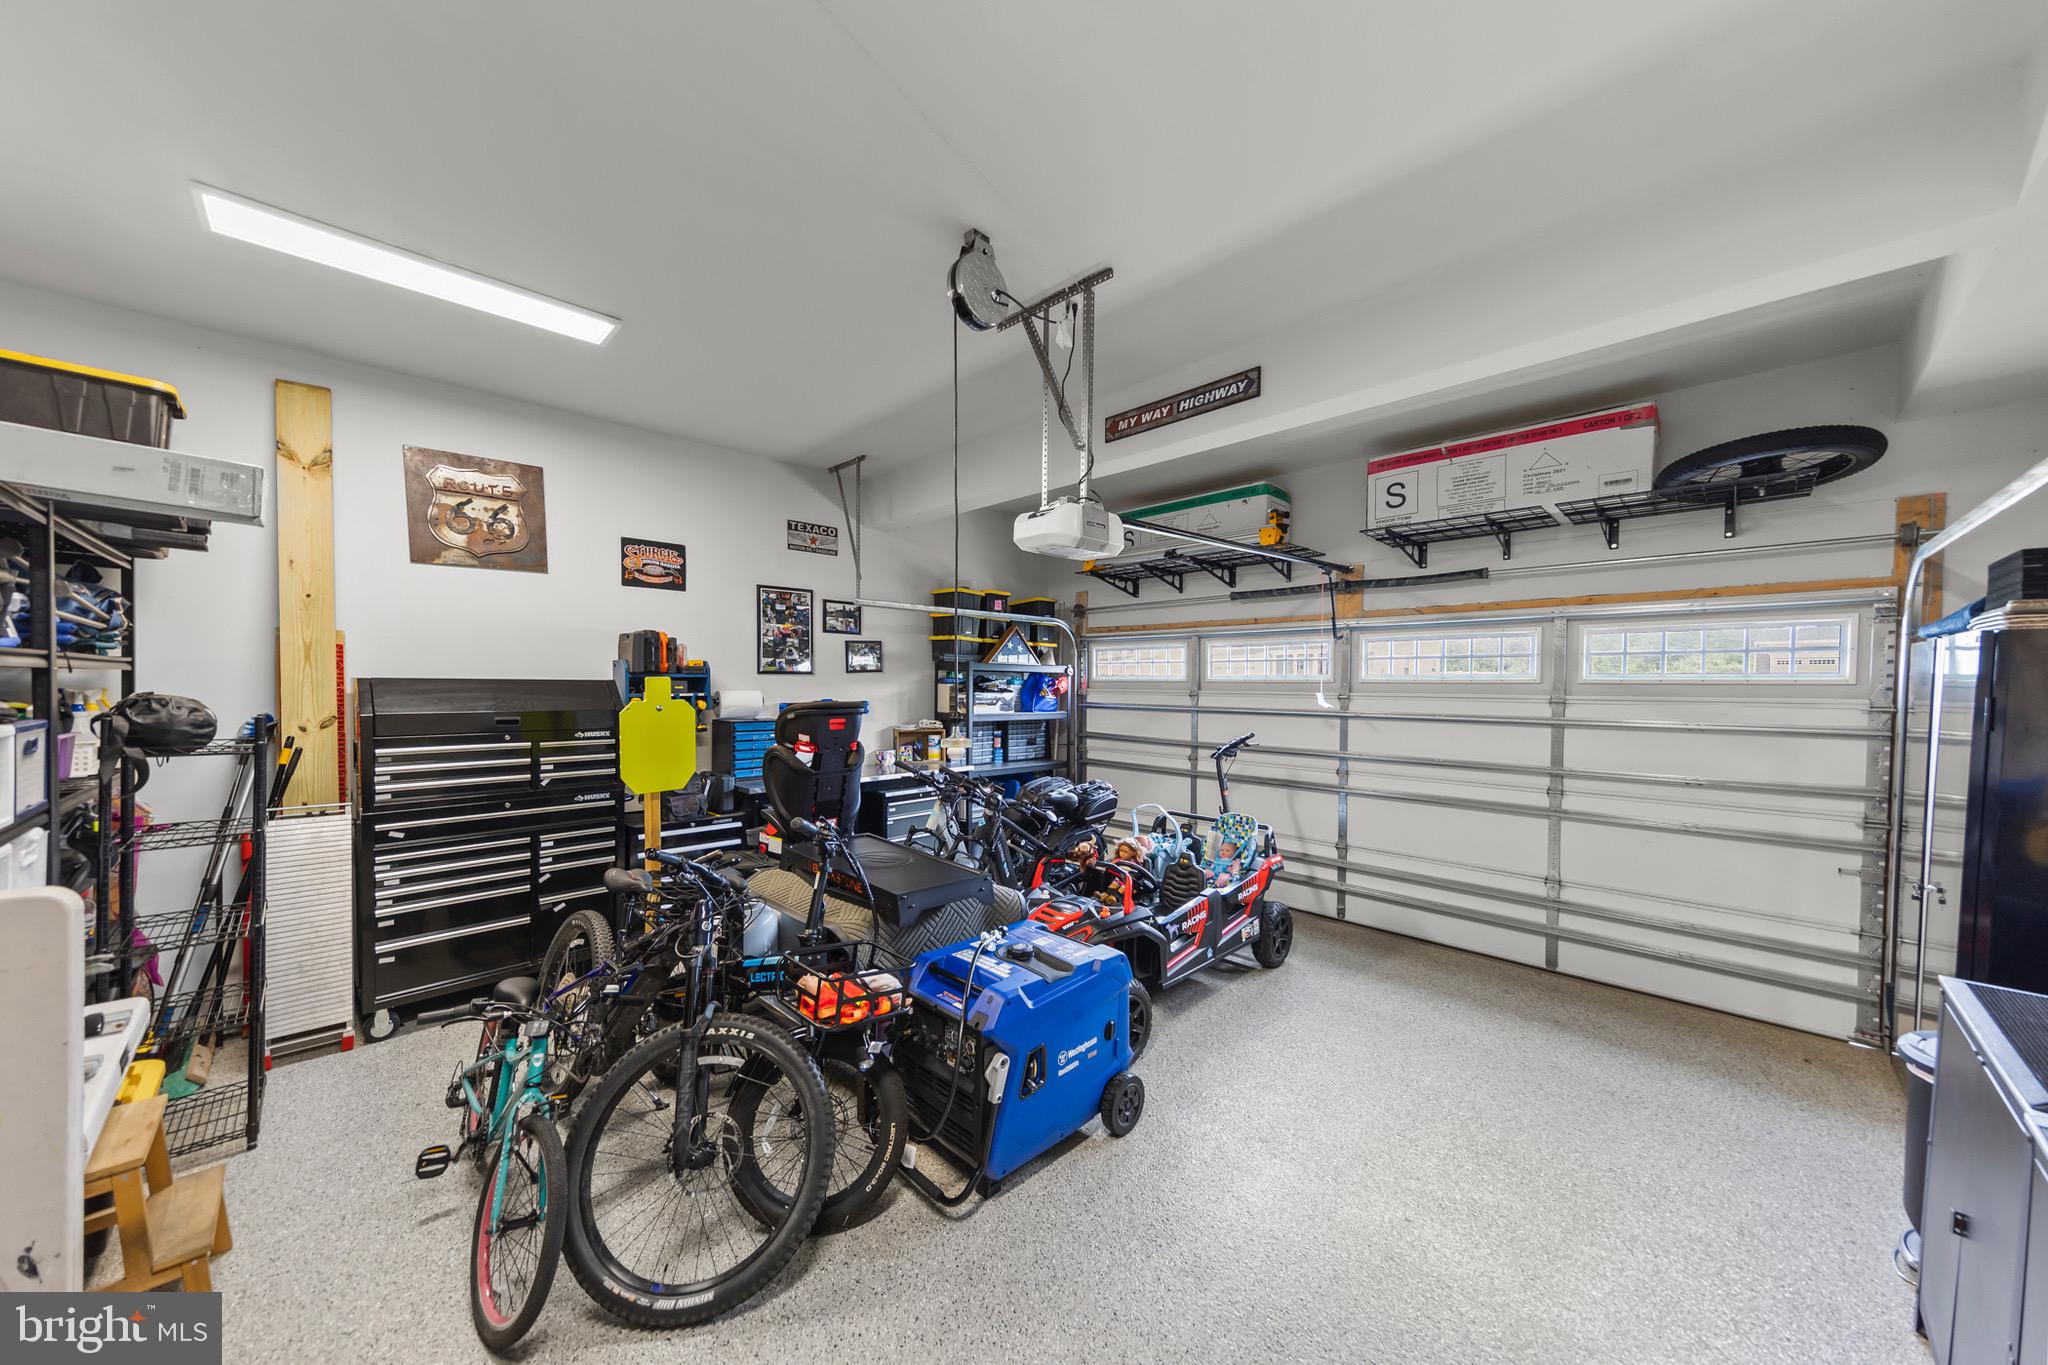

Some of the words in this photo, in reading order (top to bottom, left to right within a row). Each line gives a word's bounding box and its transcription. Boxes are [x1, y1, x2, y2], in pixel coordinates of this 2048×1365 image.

[1118, 416, 1137, 431] MY
[1141, 405, 1171, 424] WAY
[1178, 379, 1248, 412] HIGHWAY
[1583, 417, 1615, 429] CARTON
[443, 477, 513, 497] ROUTE
[1385, 482, 1407, 509] S
[446, 498, 516, 540] 66
[790, 521, 836, 536] TEXACO
[624, 545, 683, 565] STURGIS
[584, 730, 611, 738] HUSKY
[584, 792, 610, 800] HUSKY
[1237, 883, 1259, 901] RACING
[1181, 910, 1207, 931] RACING
[705, 1027, 756, 1040] AXXIS
